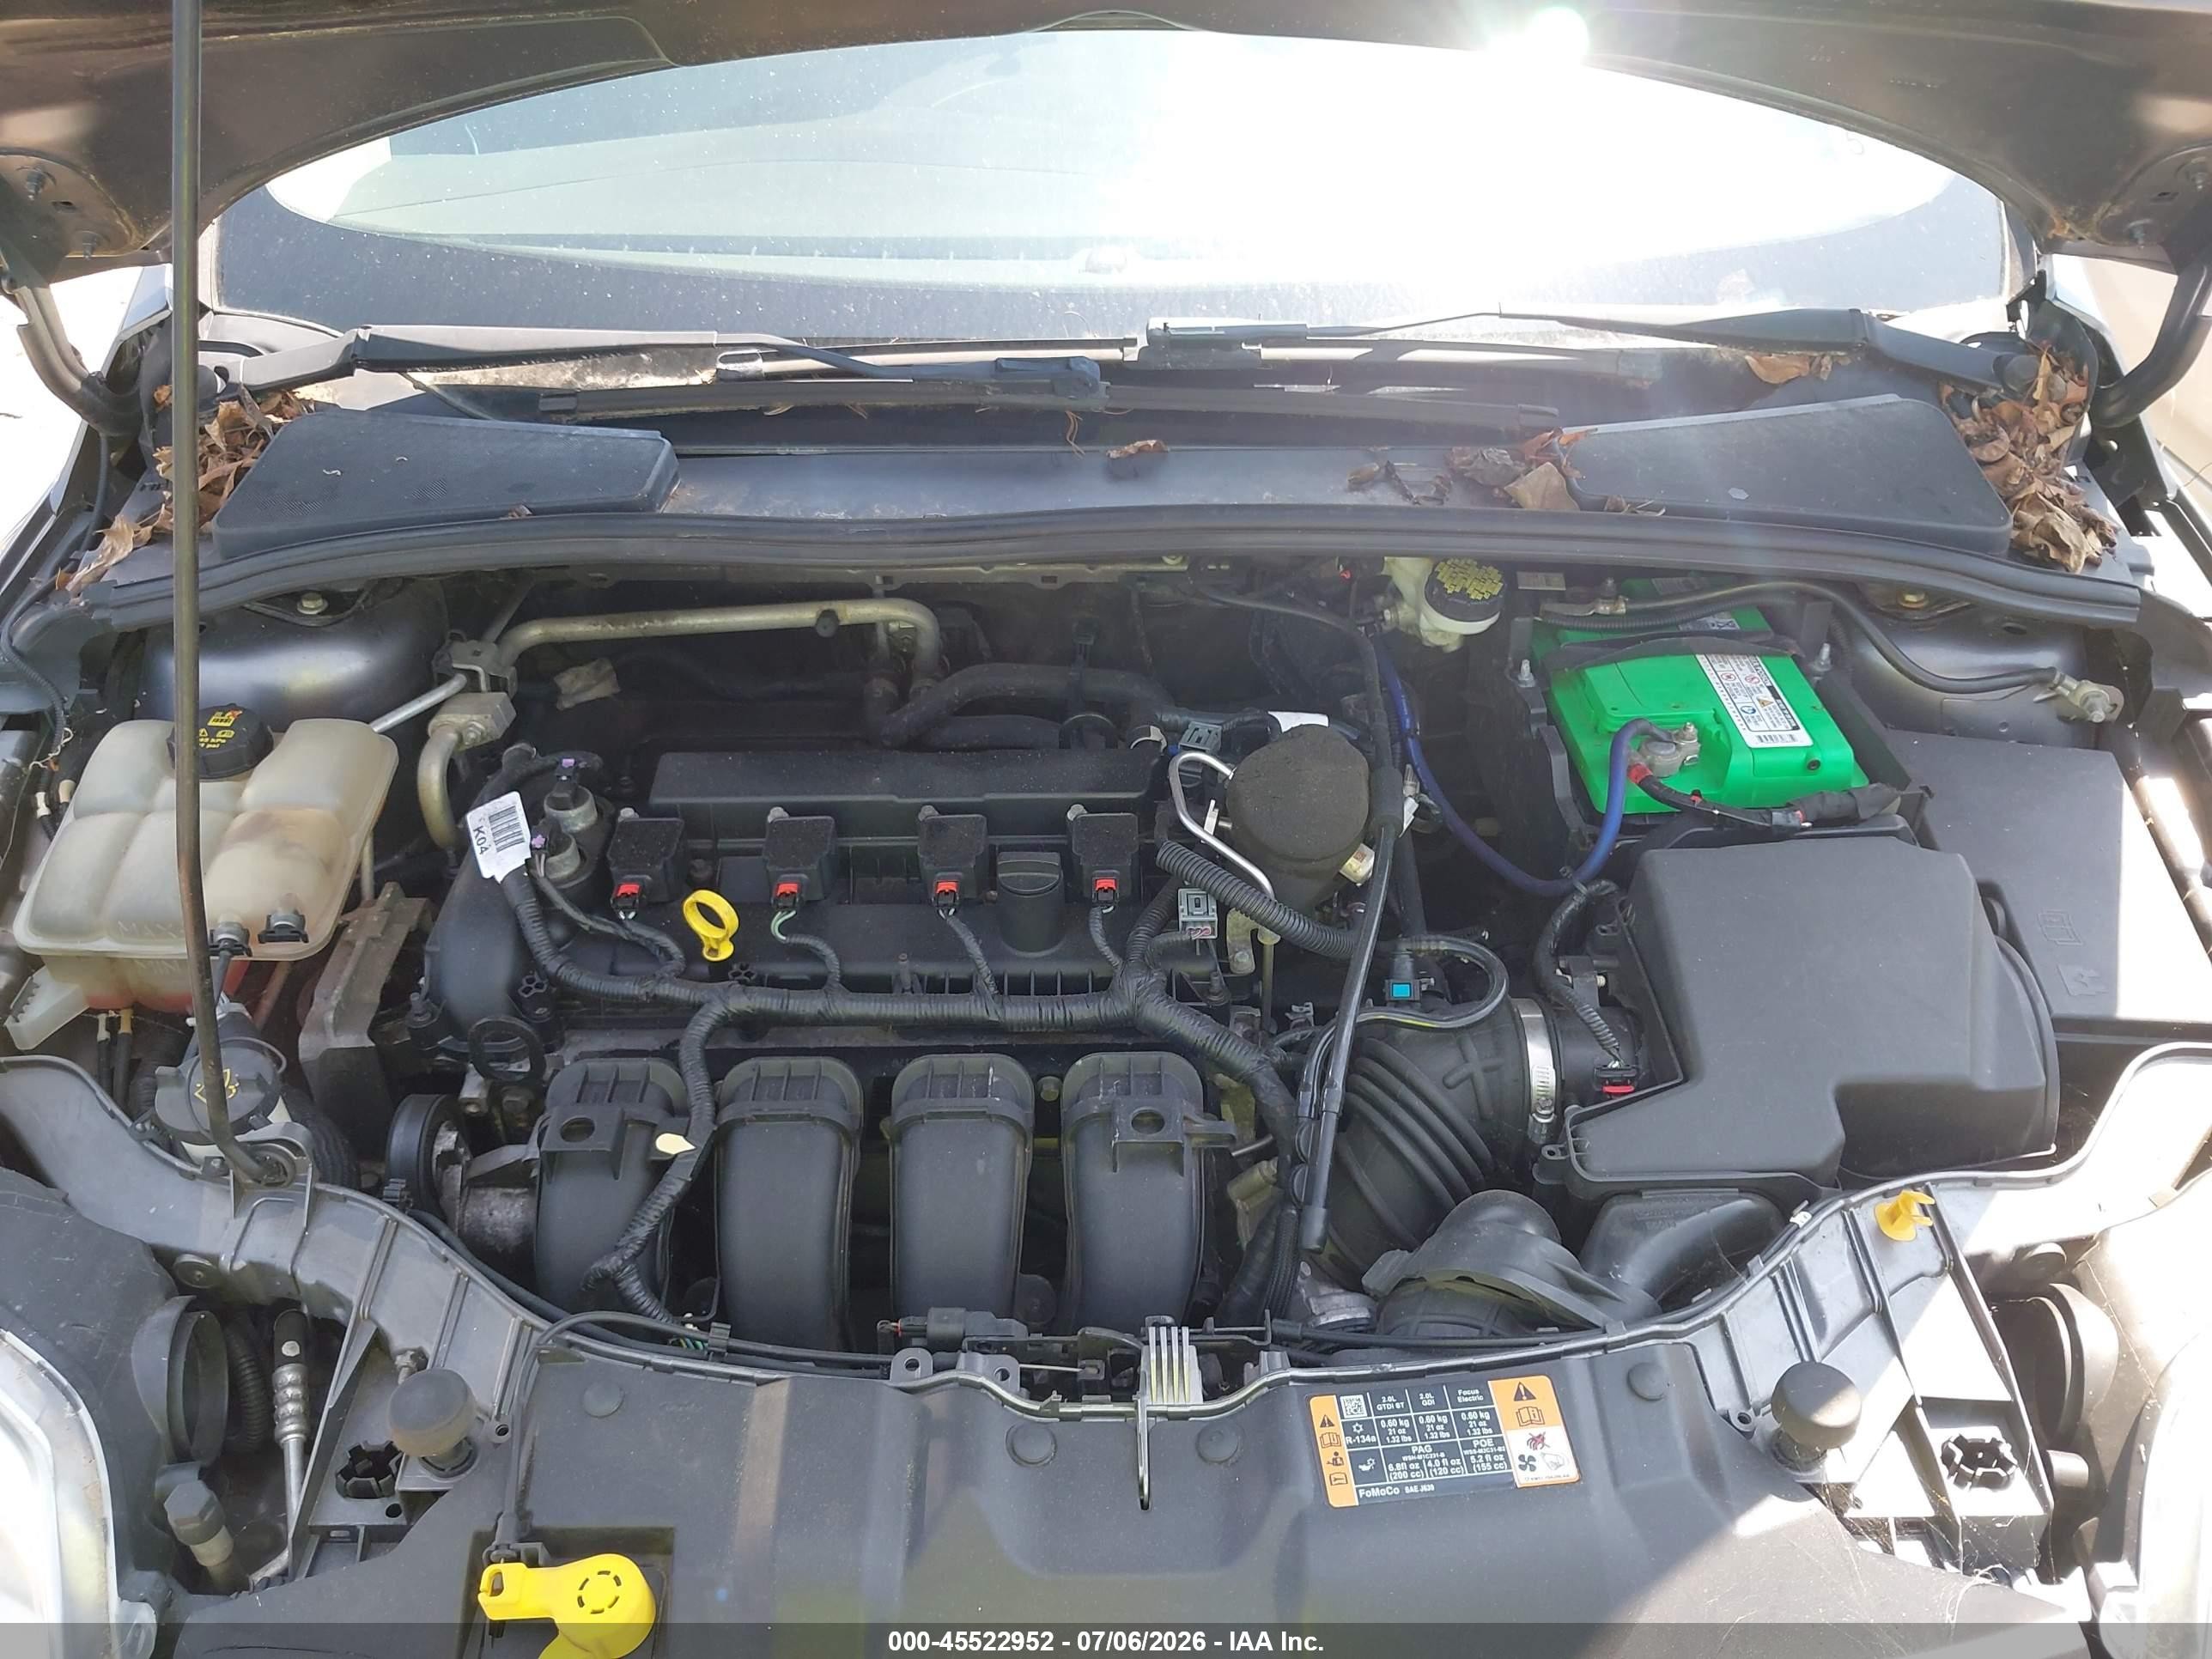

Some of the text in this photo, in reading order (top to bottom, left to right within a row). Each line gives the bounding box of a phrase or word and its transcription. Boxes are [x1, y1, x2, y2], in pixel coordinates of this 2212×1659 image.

[473, 825, 489, 855] K04
[1419, 1414, 1448, 1425] 0.60 kg
[1461, 1410, 1491, 1420] 0.60 kg
[1381, 1418, 1410, 1428] 0.60 kg
[1345, 1435, 1376, 1445] R-134a
[1425, 1431, 1438, 1440] 1.32
[1473, 1438, 1494, 1448] POE
[1412, 1444, 1432, 1454] PAG
[1470, 1455, 1484, 1463] 5.2
[1429, 1466, 1465, 1477] (120 cc)
[1473, 1462, 1508, 1473] (155 cc)
[1389, 1469, 1425, 1481] (200 cc)
[1358, 1486, 1400, 1498] FoMoCo
